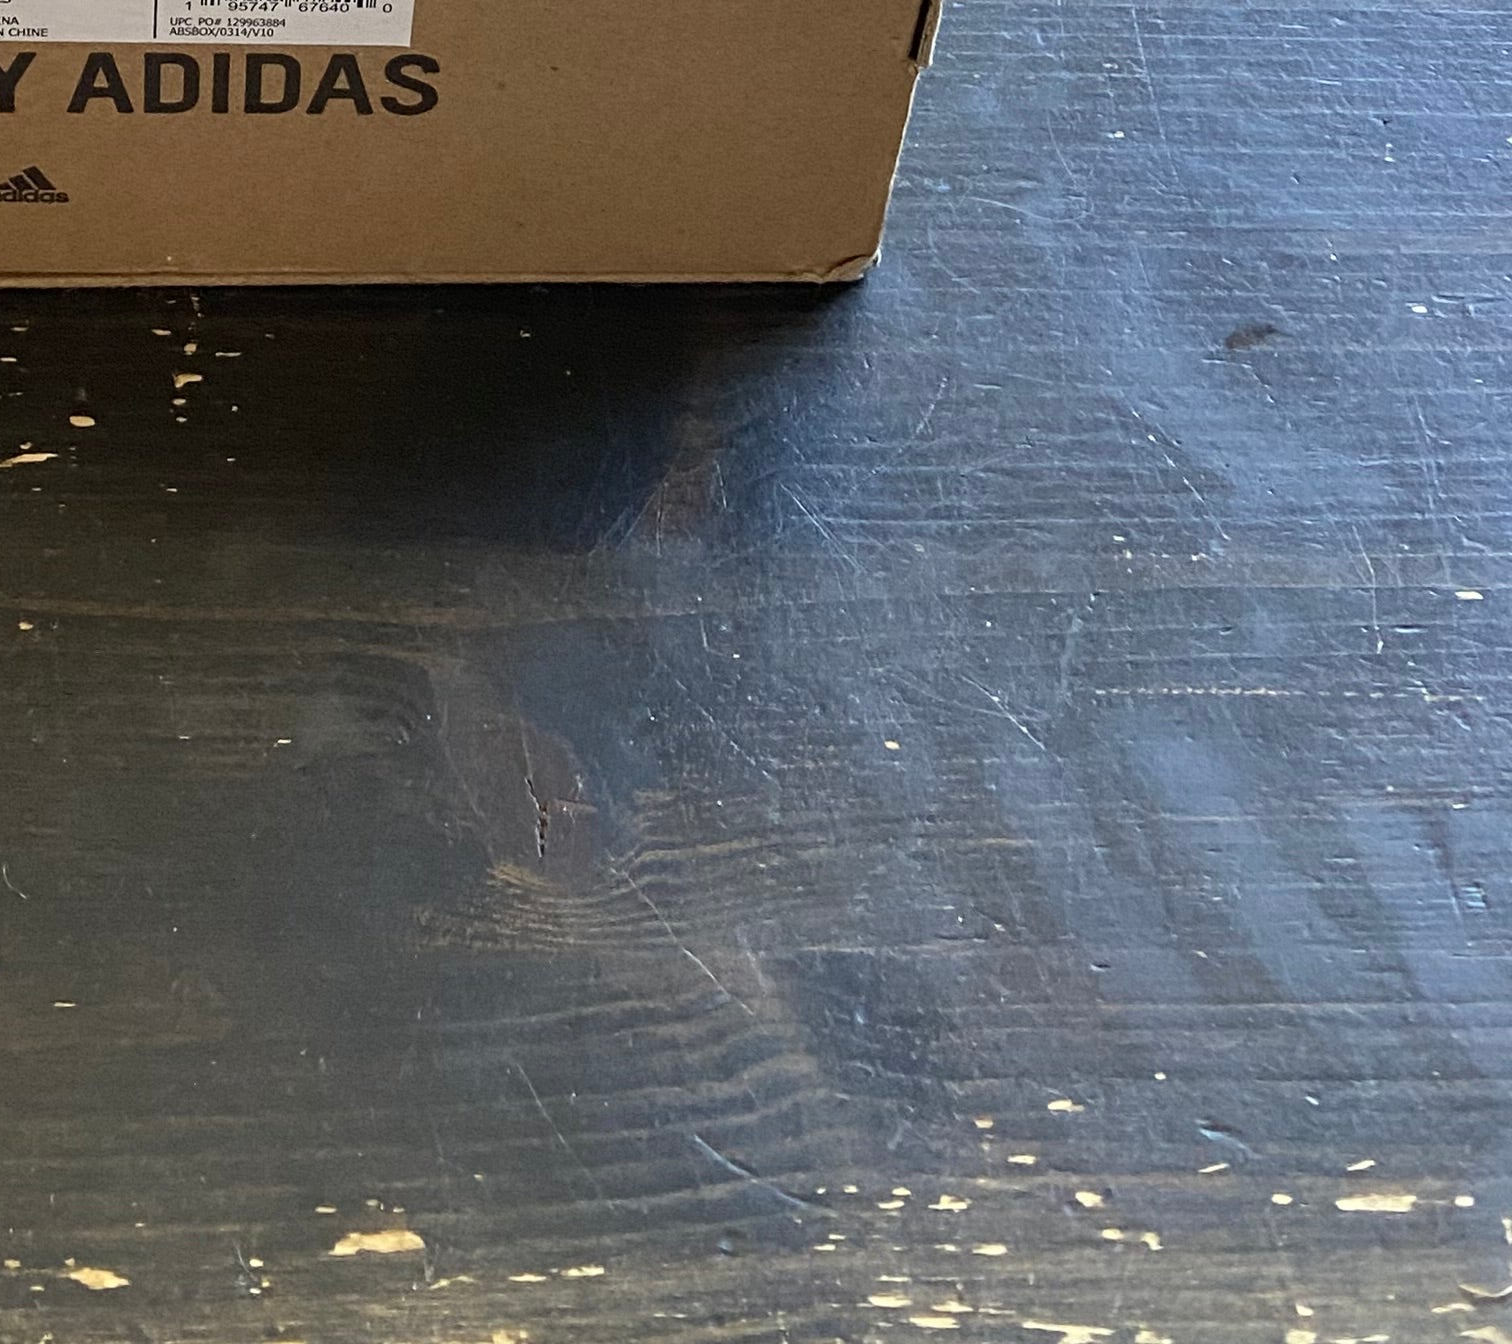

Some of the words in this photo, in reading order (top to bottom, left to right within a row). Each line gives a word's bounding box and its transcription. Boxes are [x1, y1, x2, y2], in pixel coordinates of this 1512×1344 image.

[185, 1, 192, 11] 1
[227, 2, 280, 12] 95747
[298, 2, 350, 12] 67640
[382, 3, 393, 13] 0
[170, 17, 192, 26] UPC
[197, 17, 220, 26] PO#
[226, 17, 286, 28] 129963884
[8, 27, 49, 37] CHINE
[66, 52, 441, 115] ADIDAS
